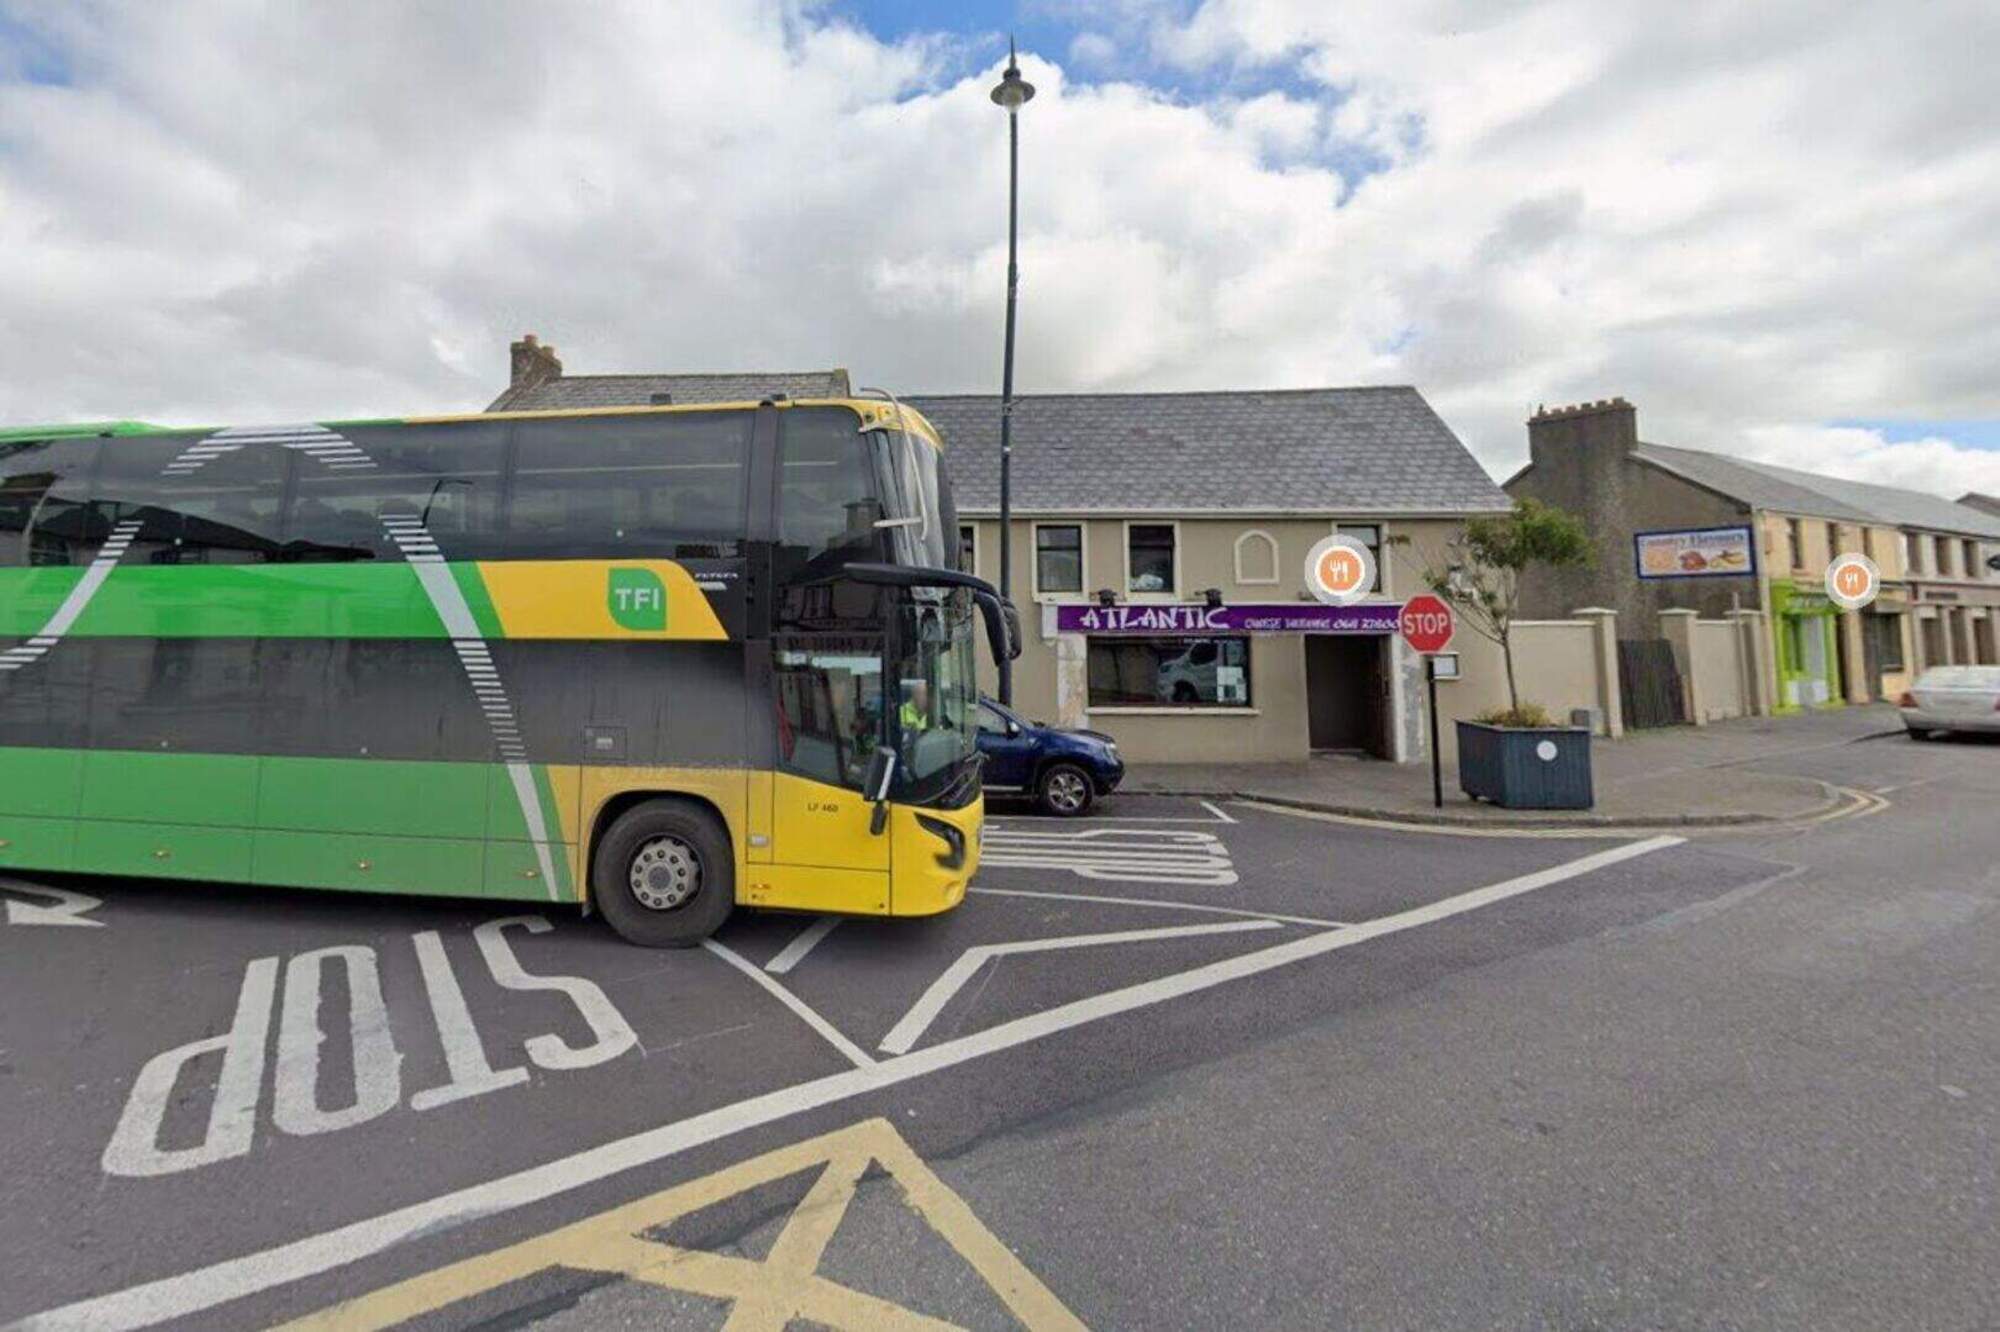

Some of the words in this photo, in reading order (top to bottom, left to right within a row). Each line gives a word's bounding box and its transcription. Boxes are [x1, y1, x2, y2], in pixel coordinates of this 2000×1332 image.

[615, 587, 660, 611] TFI
[1079, 606, 1230, 629] ATLANTIC
[1404, 613, 1448, 635] STOP
[102, 915, 638, 1177] STOP
